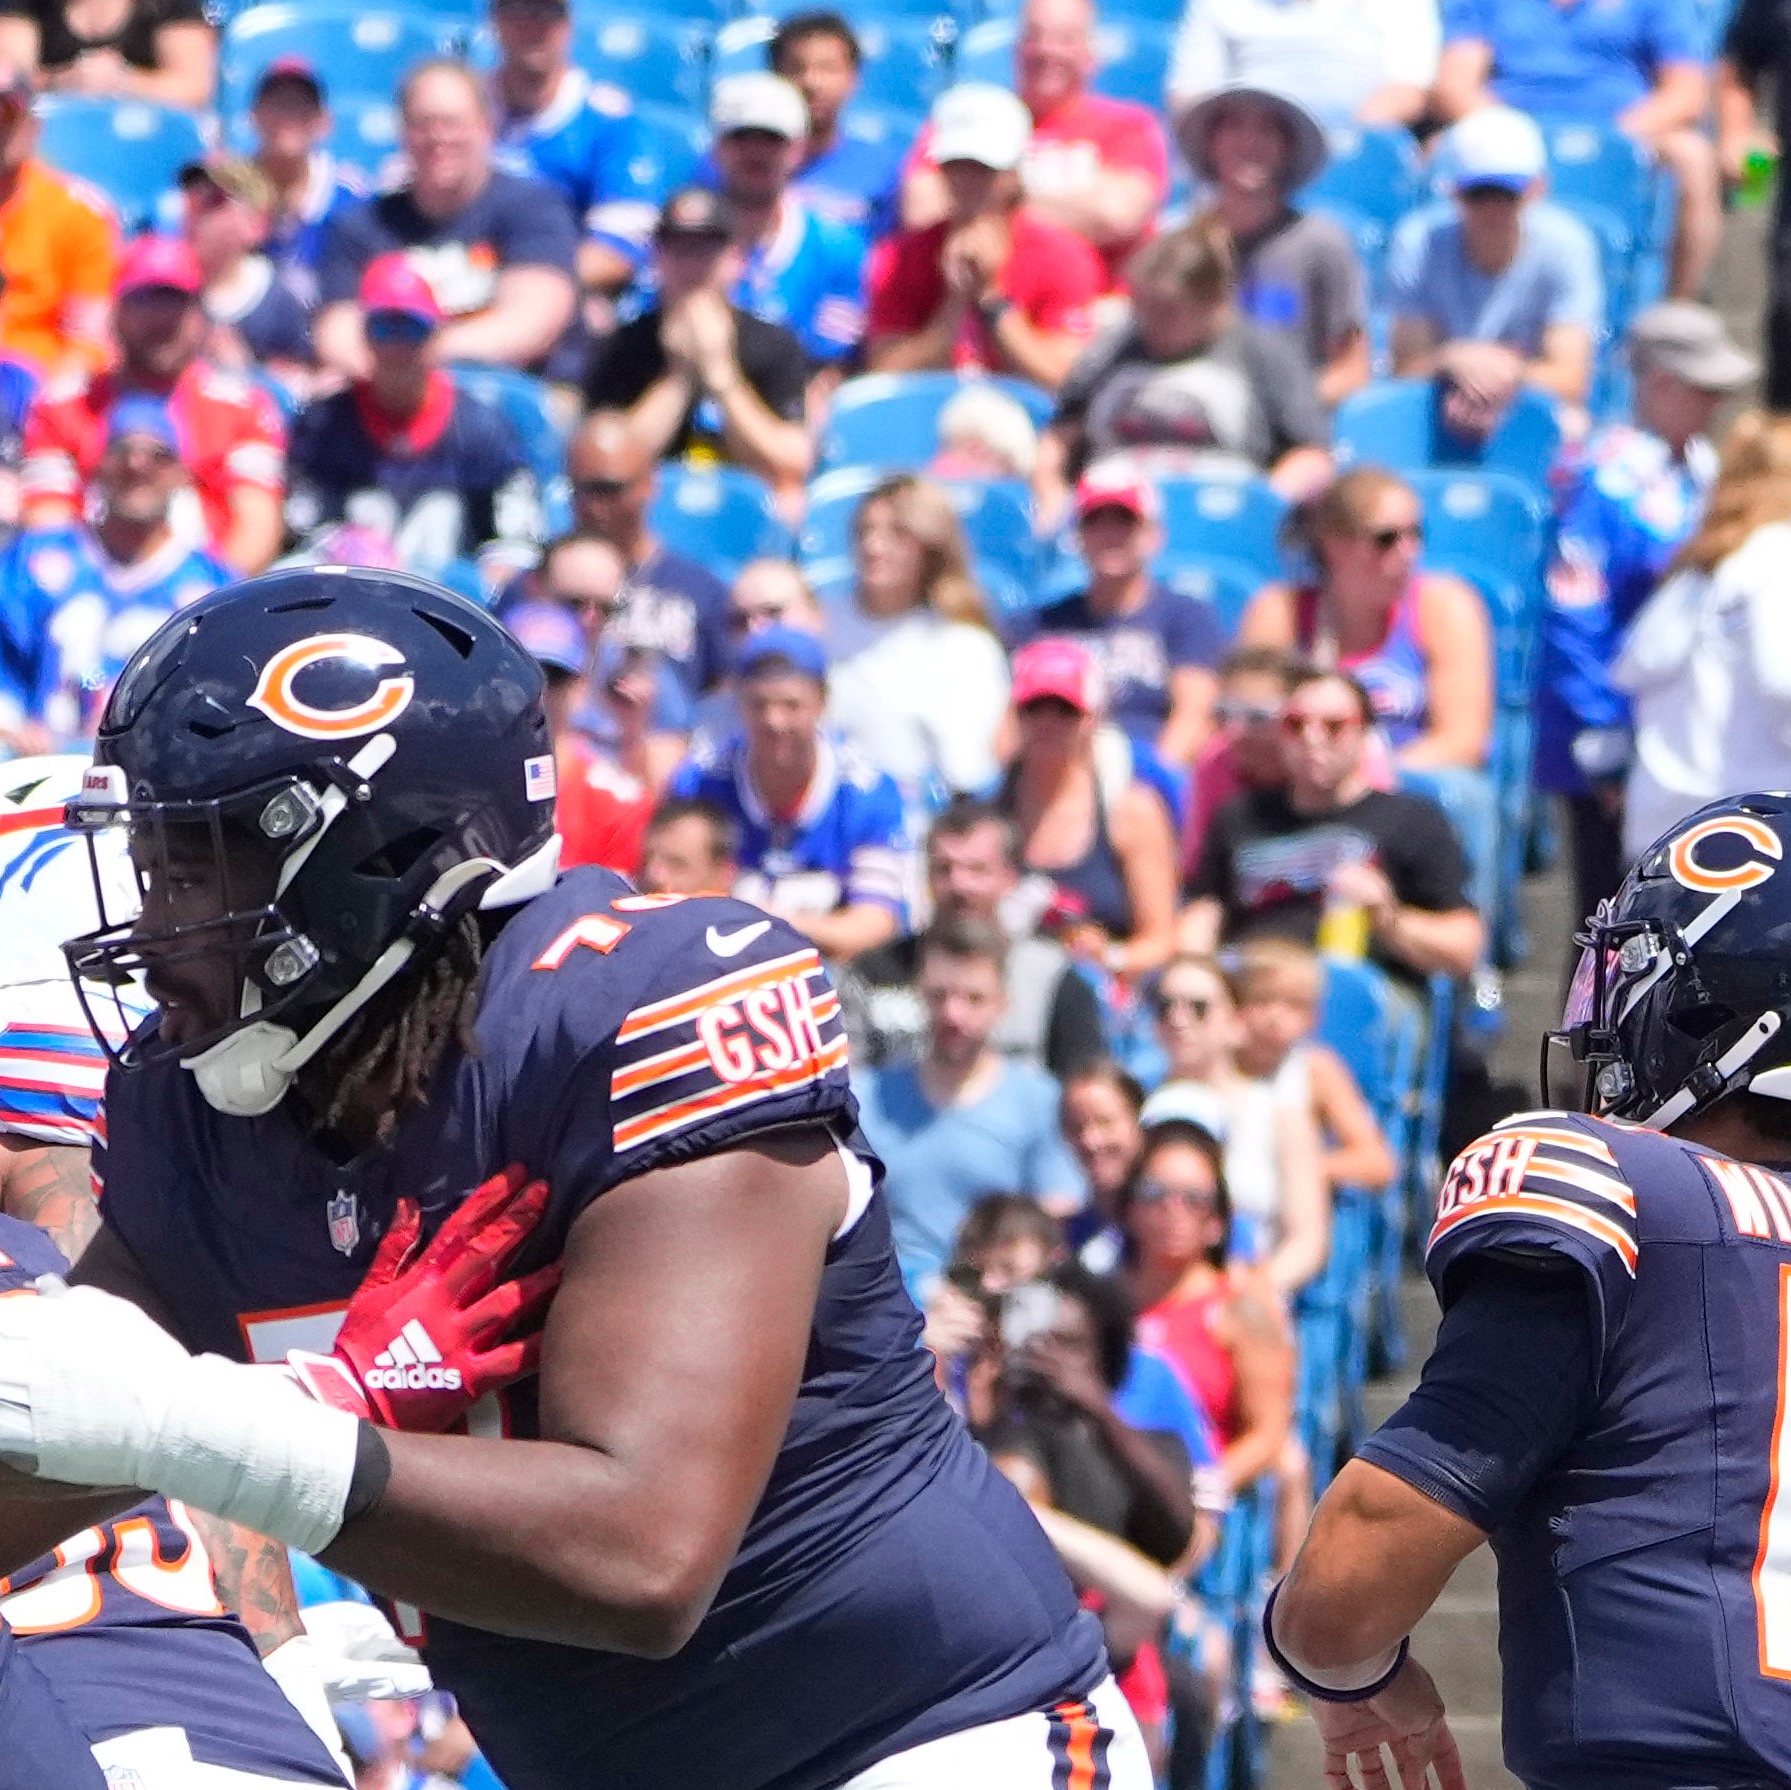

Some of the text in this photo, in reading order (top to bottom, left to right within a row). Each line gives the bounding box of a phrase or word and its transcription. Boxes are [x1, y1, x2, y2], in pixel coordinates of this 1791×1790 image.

[84, 775, 108, 790] ARS
[696, 974, 824, 1084] GSH
[1437, 1134, 1541, 1218] GSH
[364, 1362, 463, 1390] adidas
